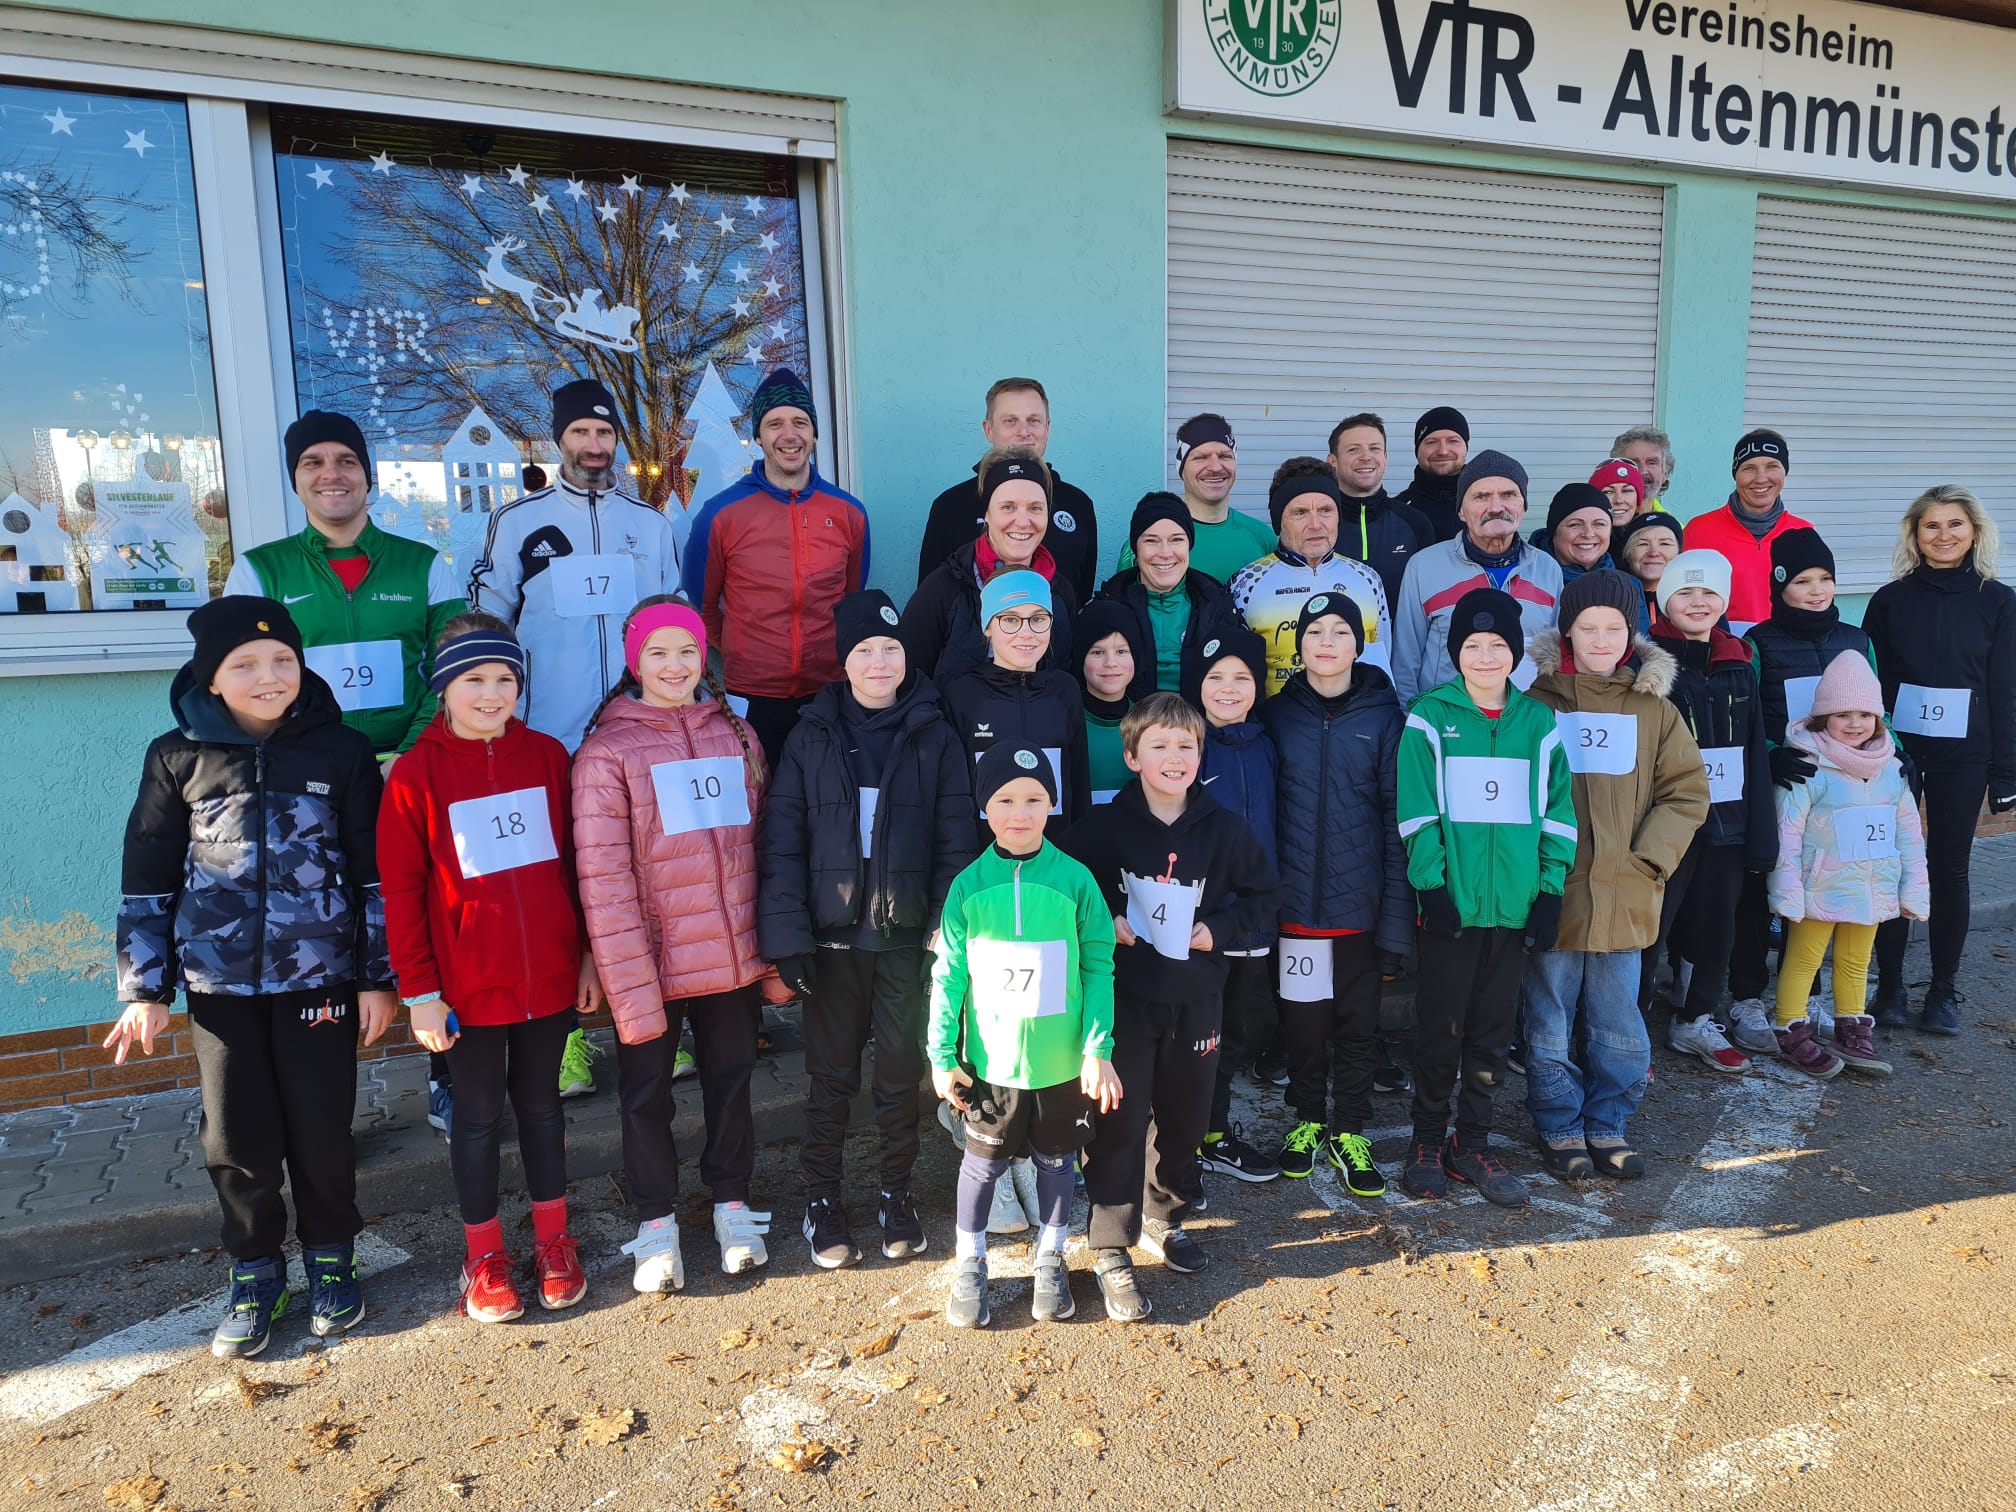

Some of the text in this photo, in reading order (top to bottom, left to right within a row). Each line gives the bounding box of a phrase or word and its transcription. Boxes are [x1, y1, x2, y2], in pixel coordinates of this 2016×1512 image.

[1208, 0, 1338, 89] TENMÜNSTE
[1625, 0, 1894, 71] Vereinsheim
[1601, 48, 2016, 178] Altenmünst
[584, 575, 611, 596] 17
[341, 665, 374, 688] 29
[1919, 704, 1945, 721] 19
[1580, 727, 1609, 748] 32
[1703, 762, 1726, 781] 24
[690, 776, 721, 800] 10
[1484, 780, 1500, 801] 9
[490, 811, 526, 840] 18
[1865, 823, 1886, 842] 25
[1151, 903, 1168, 926] 4
[1286, 955, 1314, 977] 20
[1002, 968, 1035, 992] 27
